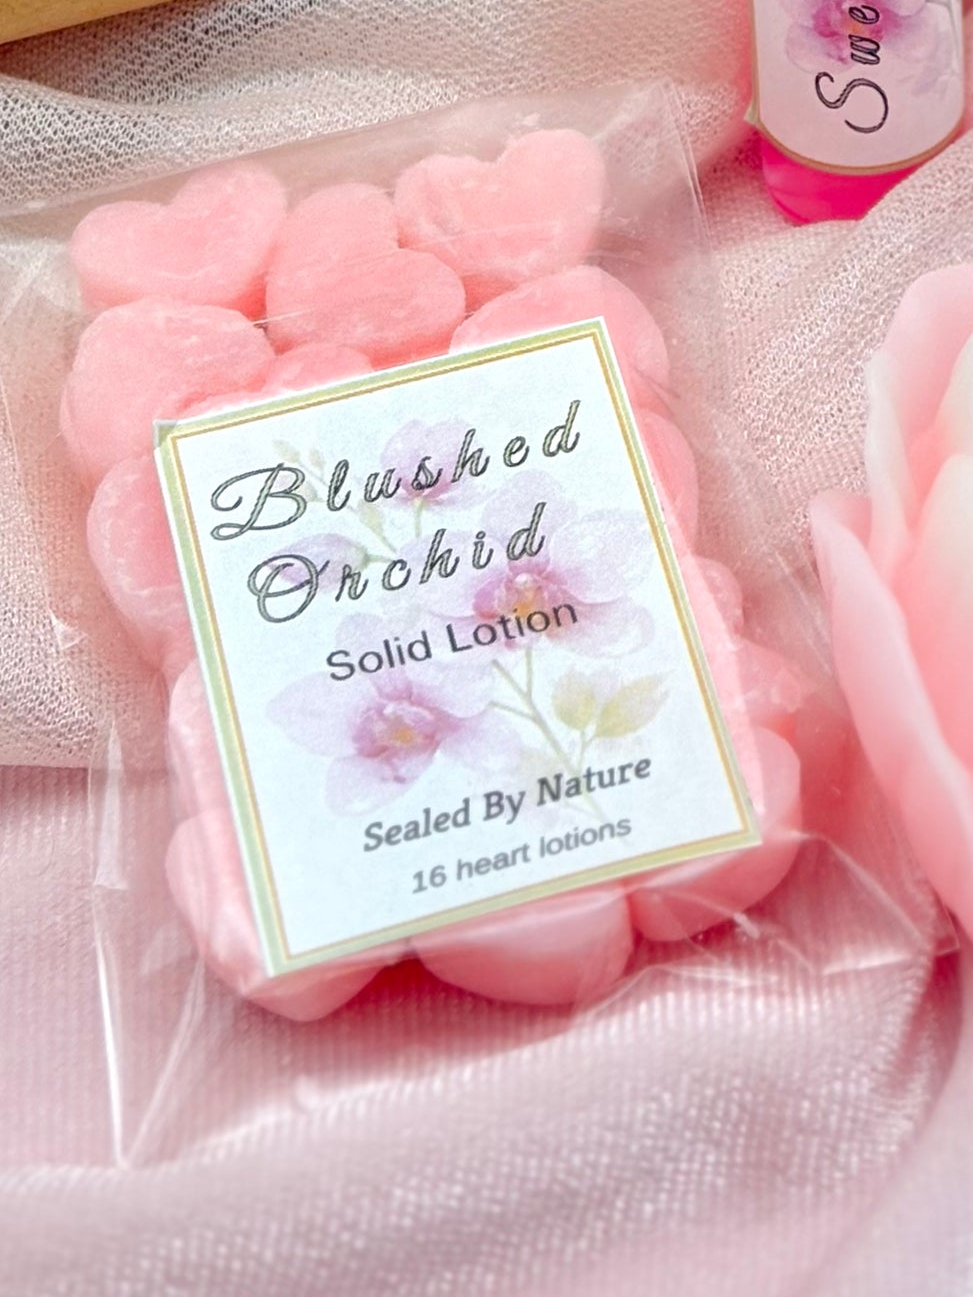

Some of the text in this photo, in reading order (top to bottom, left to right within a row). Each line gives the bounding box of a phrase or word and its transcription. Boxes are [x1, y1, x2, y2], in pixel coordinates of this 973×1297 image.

[210, 399, 582, 541] Blushed
[247, 501, 547, 623] Orchid
[325, 602, 579, 682] Solid Lotion
[363, 757, 652, 852] Sealed By Nature
[411, 815, 632, 894] 16 heart lotions
